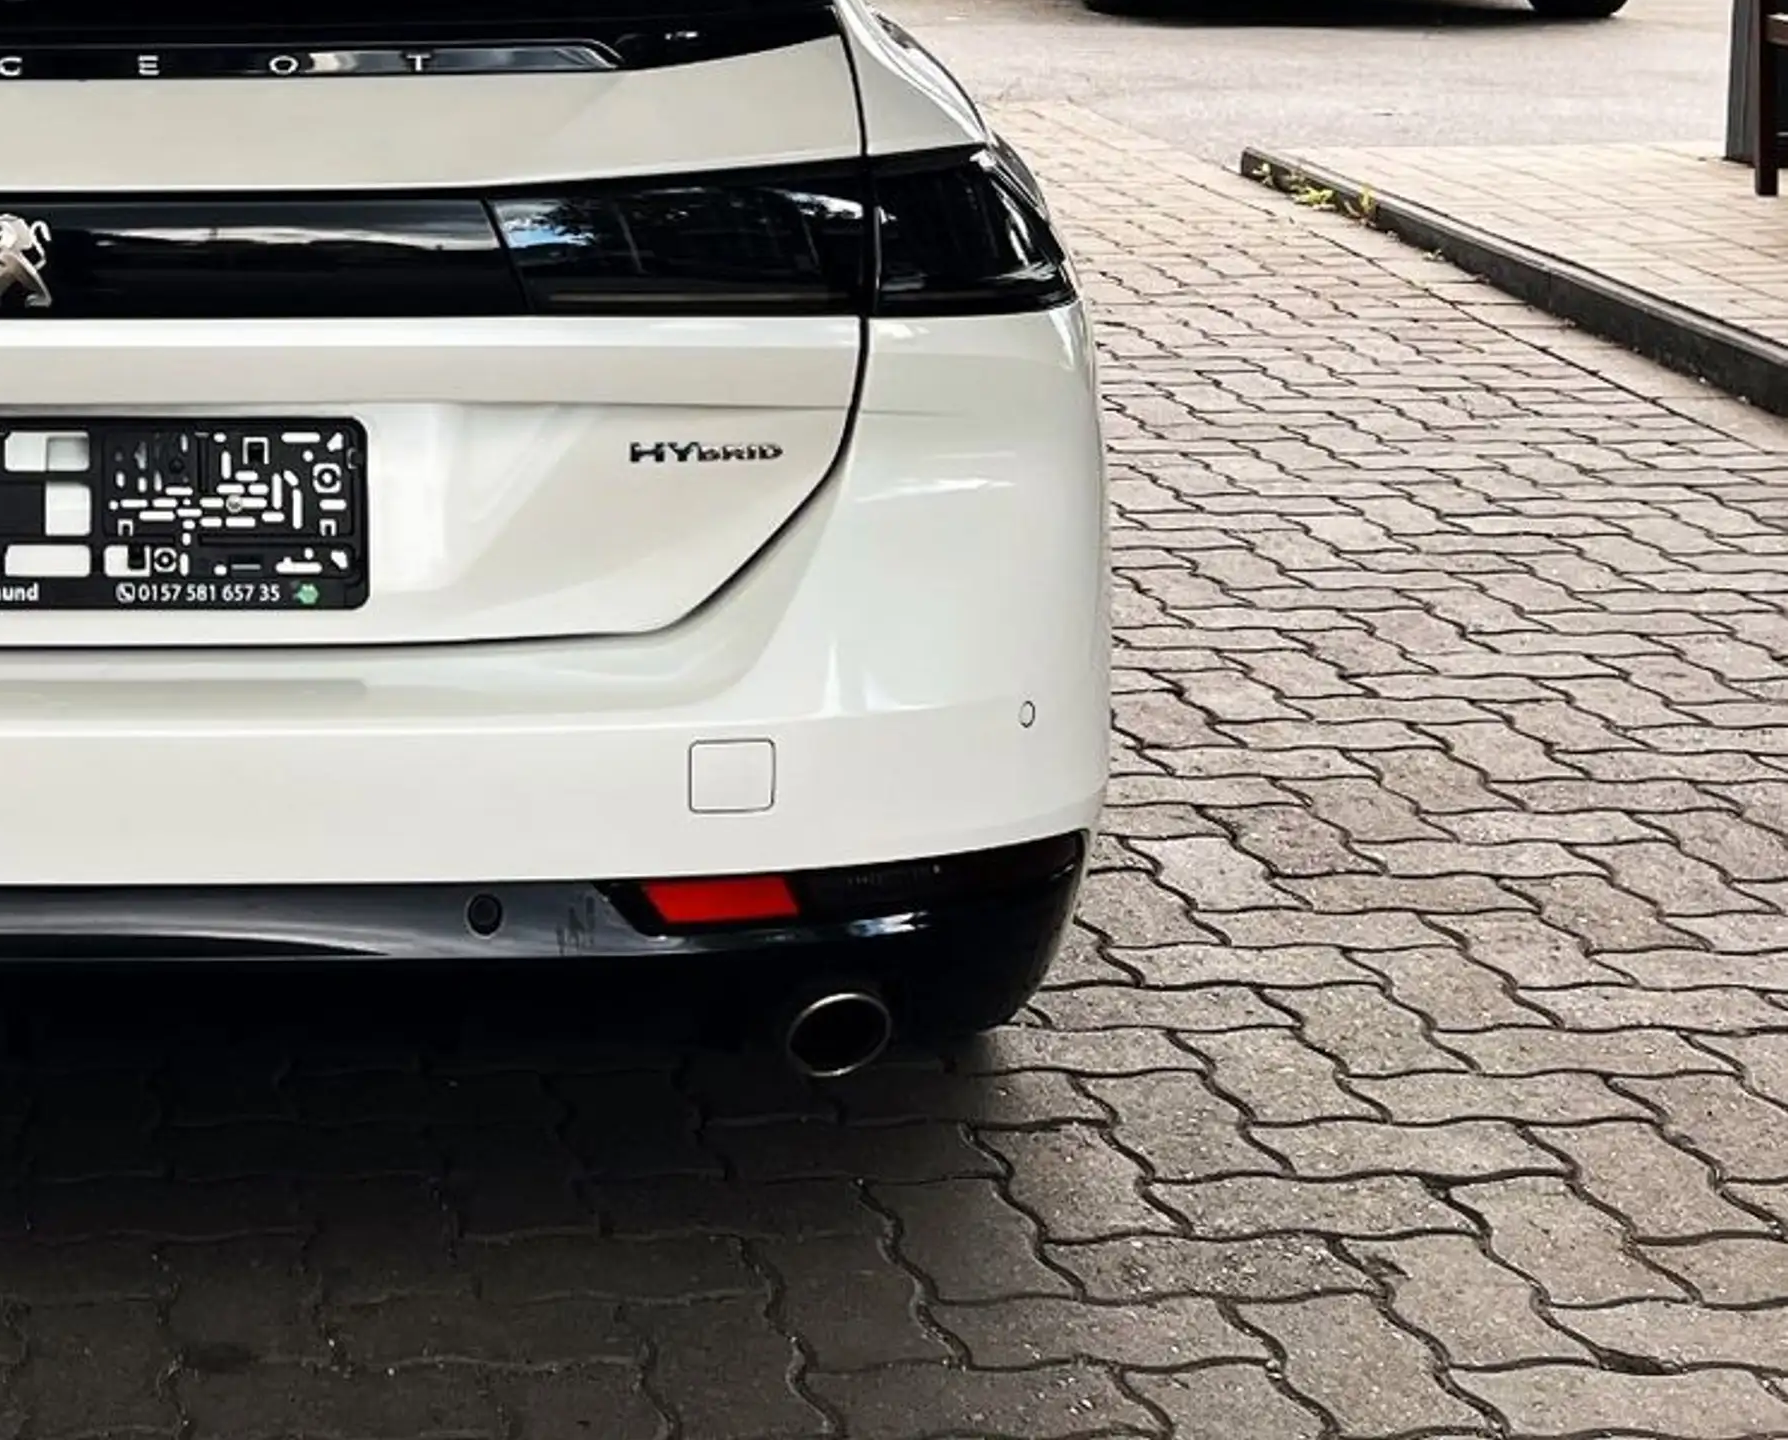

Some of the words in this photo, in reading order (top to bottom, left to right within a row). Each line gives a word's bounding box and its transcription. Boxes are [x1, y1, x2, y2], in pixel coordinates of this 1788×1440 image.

[138, 583, 181, 602] 0157
[186, 583, 216, 602] 581
[222, 583, 254, 602] 657
[259, 583, 281, 602] 35
